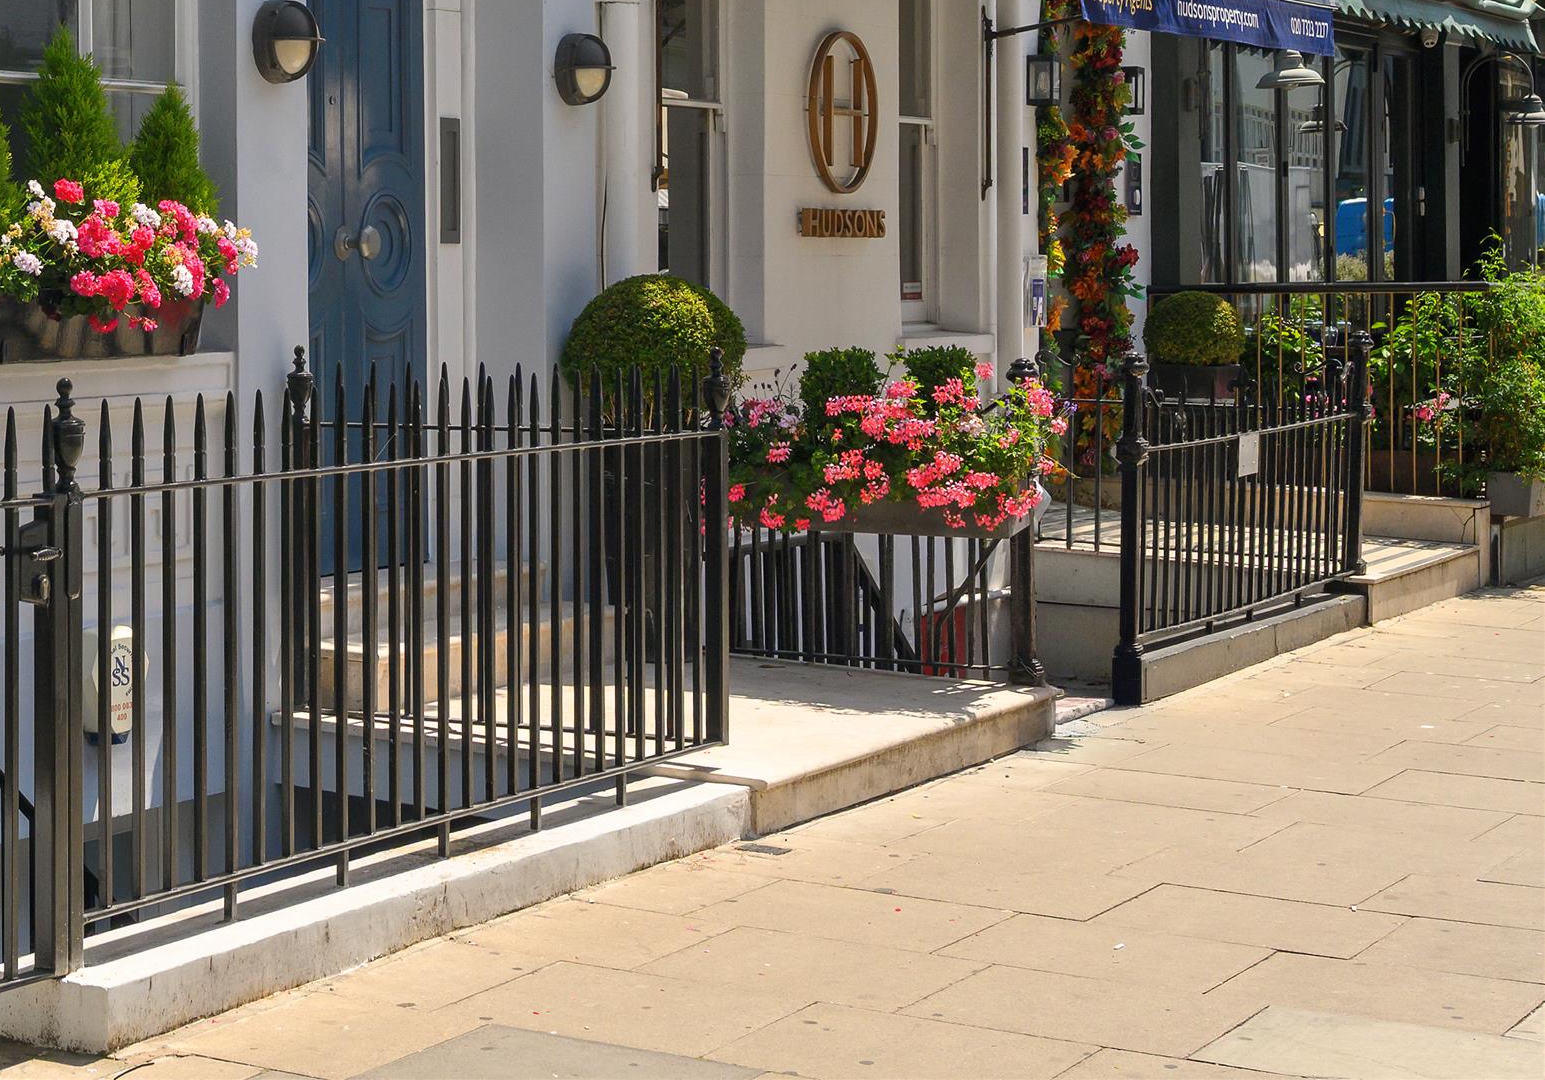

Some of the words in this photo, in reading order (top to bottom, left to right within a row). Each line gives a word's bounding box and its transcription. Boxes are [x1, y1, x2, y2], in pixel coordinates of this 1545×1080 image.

[1290, 17, 1302, 35] 020
[1302, 19, 1315, 37] 7323
[1315, 21, 1329, 38] 2277
[804, 208, 886, 236] HUDSONS
